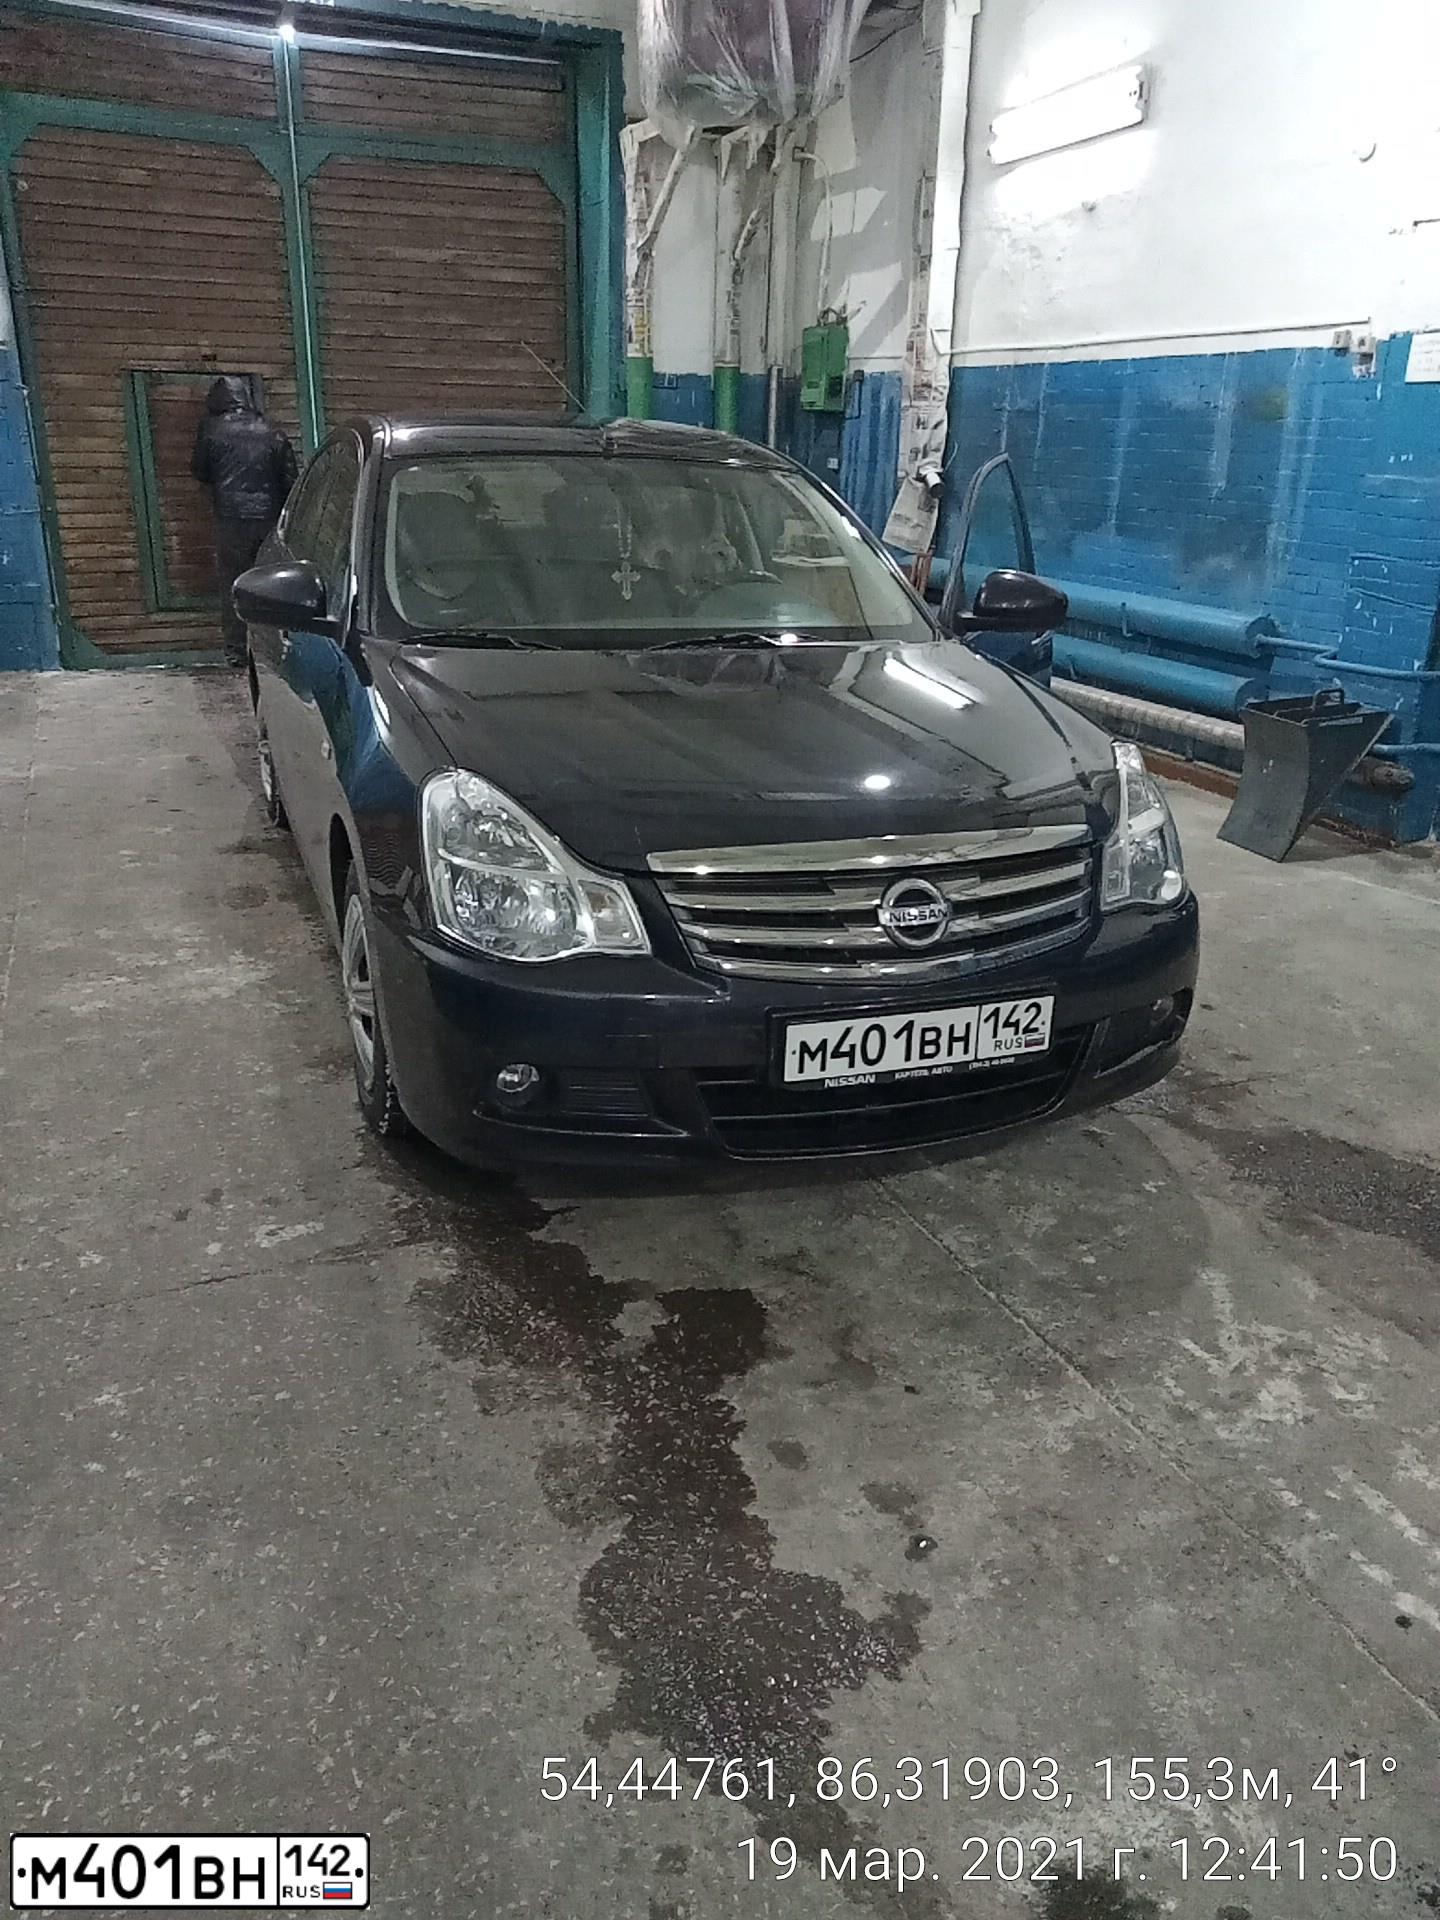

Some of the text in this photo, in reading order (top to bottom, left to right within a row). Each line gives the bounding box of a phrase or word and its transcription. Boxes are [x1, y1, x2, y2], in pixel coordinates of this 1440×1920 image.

[889, 908, 948, 923] NISSAN
[984, 1002, 1042, 1039] 142
[994, 1036, 1023, 1051] RUS
[824, 1074, 876, 1088] NISSAN
